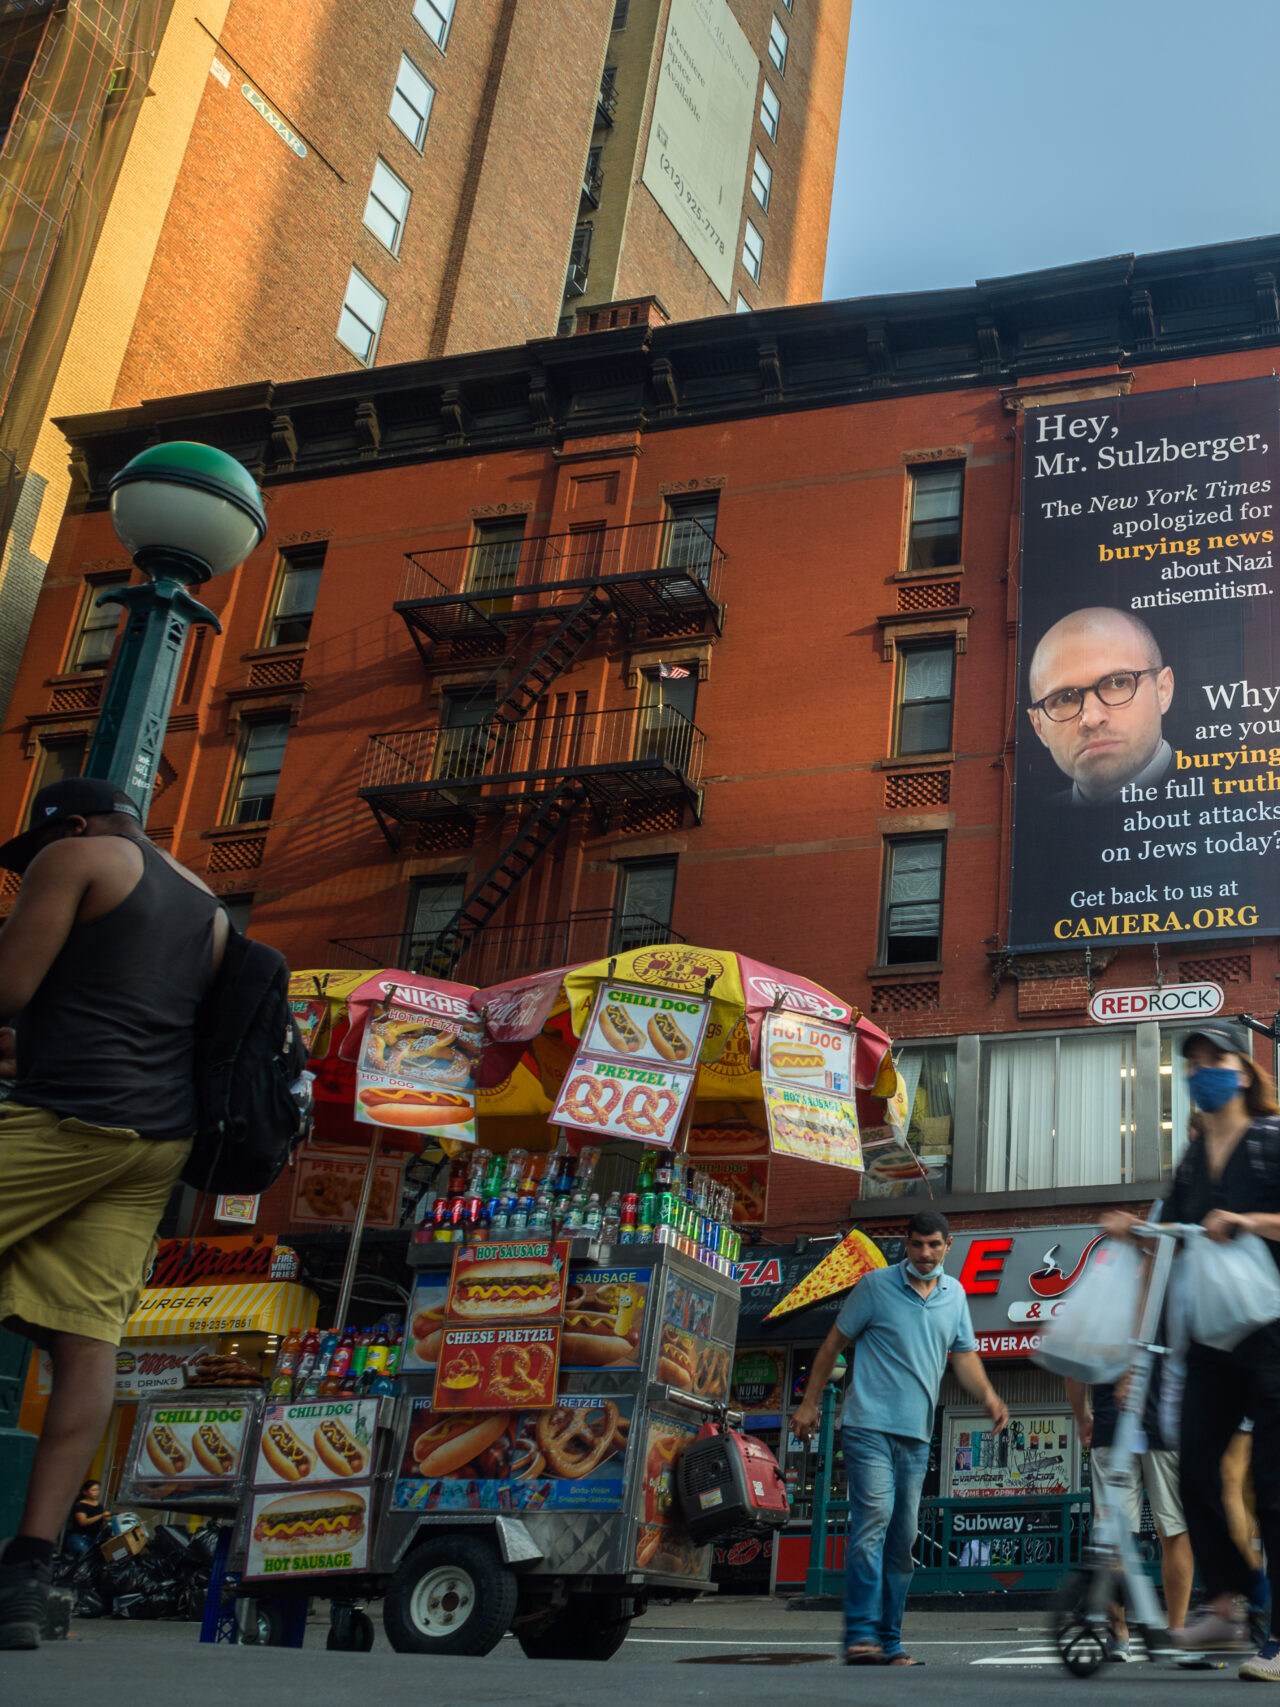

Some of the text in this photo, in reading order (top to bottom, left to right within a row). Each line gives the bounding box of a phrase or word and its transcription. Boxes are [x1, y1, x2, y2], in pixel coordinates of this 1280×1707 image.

[667, 42, 692, 84] Space
[670, 24, 706, 88] Premiere
[664, 62, 702, 122] Available
[245, 90, 301, 151] LAMAR
[660, 153, 684, 196] (212)
[685, 191, 725, 255] 925-7778
[1035, 413, 1119, 443] Hey,
[1034, 432, 1269, 478] Mr. Sulzberger,
[1041, 479, 1271, 519] The New York Times
[1112, 502, 1272, 538] apologized for
[1098, 529, 1274, 562] burying news
[1161, 551, 1273, 580] about Nazi
[1130, 580, 1274, 610] antisemitism.
[1195, 722, 1232, 740] are
[1120, 783, 1157, 803] the
[1165, 777, 1204, 800] full
[1123, 809, 1191, 832] about
[1101, 847, 1130, 862] on
[1138, 840, 1197, 860] Jews
[1070, 880, 1238, 908] Get back to us at
[1053, 905, 1259, 940] CAMERA.ORG
[395, 987, 469, 1013] NIKAS
[608, 990, 700, 1015] CHILI DOG
[1101, 988, 1213, 1016] REDROCK
[388, 1009, 465, 1037] HOT PRETZEL
[772, 1021, 805, 1042] HOT
[810, 1031, 842, 1051] DOG
[362, 1072, 415, 1089] HOT DOG
[595, 1063, 667, 1087] PRETZEL
[783, 1090, 840, 1112] HOT SAUSAGE
[724, 1163, 748, 1173] DOG
[475, 1243, 549, 1260] HOT SAUSAGE
[270, 1270, 296, 1279] FRIES
[271, 1262, 297, 1271] WINGS
[575, 1271, 637, 1284] SAUSAGE
[139, 1296, 214, 1310] URGER
[446, 1328, 555, 1345] CHEESE PRETZEL
[137, 1377, 178, 1388] DRINKS
[738, 1384, 765, 1396] NUMU
[155, 1408, 243, 1424] CHILI DOG
[288, 1403, 354, 1419] CHILI DOG
[1028, 1420, 1056, 1435] JUUL
[952, 1514, 1024, 1533] Subway
[263, 1553, 352, 1572] HOT SAUSAGE
